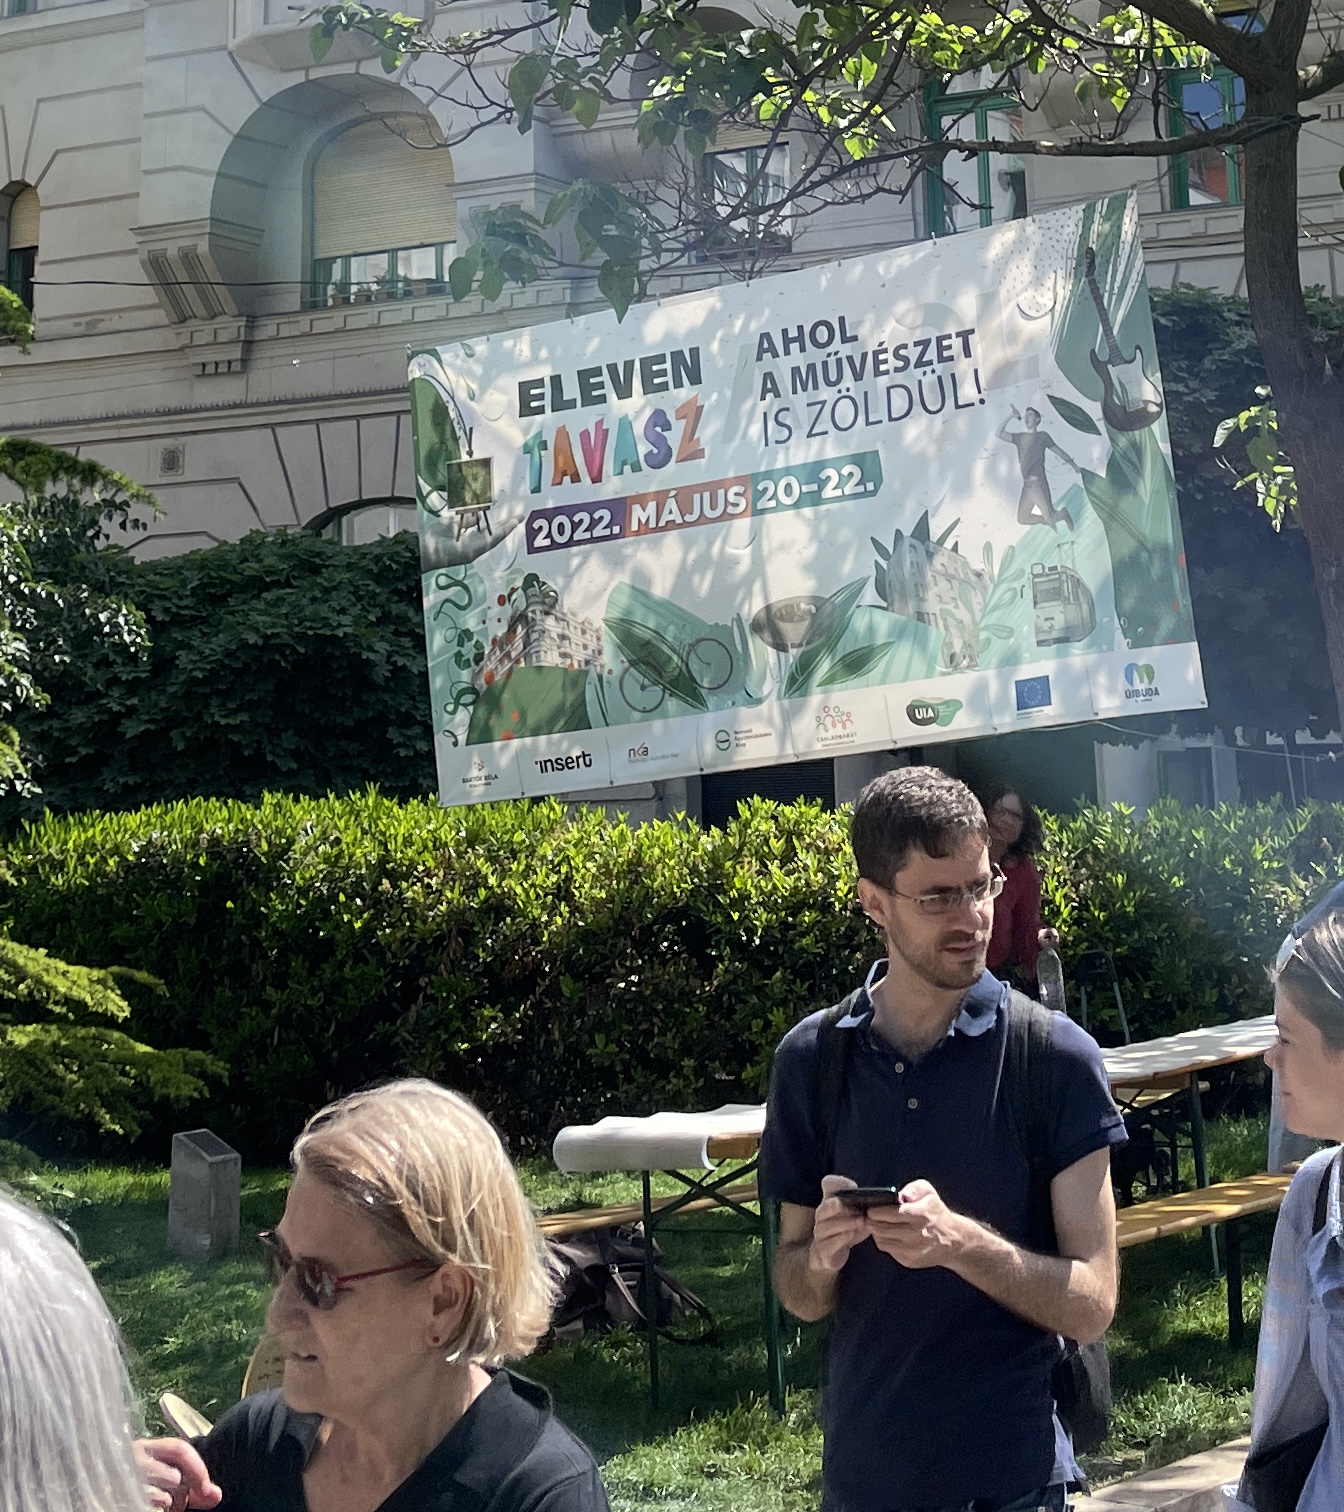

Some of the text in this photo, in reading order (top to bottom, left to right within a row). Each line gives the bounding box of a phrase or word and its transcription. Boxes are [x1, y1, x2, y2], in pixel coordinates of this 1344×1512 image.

[756, 315, 858, 362] AHOL
[759, 328, 976, 402] A MŰVÉSZET
[517, 346, 704, 418] ELEVEN
[762, 367, 986, 447] IS ZÖLDÜL!
[522, 393, 706, 494] TAVASZ
[531, 513, 621, 548] 2022.
[630, 484, 748, 531] MÁJUS
[914, 706, 935, 720] UIA
[535, 750, 593, 774] insert
